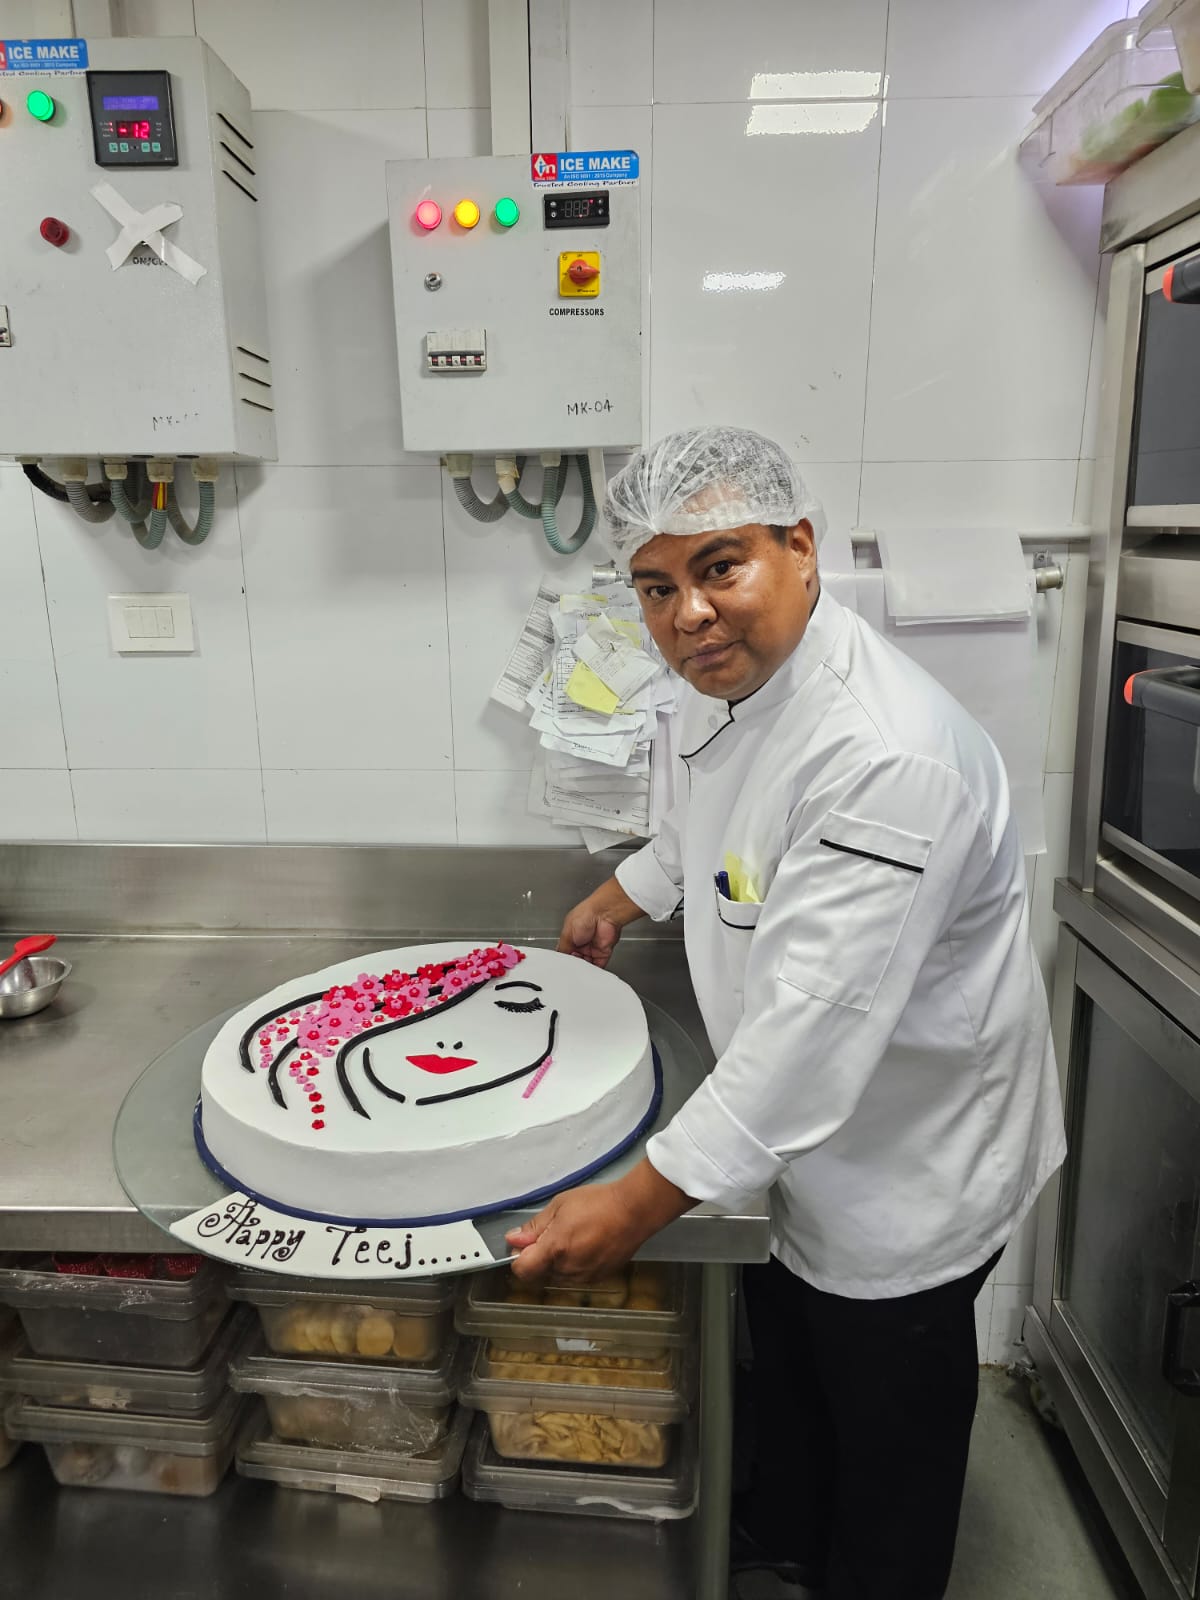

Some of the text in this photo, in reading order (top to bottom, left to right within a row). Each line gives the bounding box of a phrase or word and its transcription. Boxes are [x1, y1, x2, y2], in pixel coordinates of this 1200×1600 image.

[8, 47, 33, 60] ICE
[36, 45, 79, 59] MAKE
[560, 156, 631, 171] ICE MAKE
[549, 307, 605, 316] COMPRESSORS
[567, 399, 614, 416] MK-04
[197, 1199, 306, 1262] Happy
